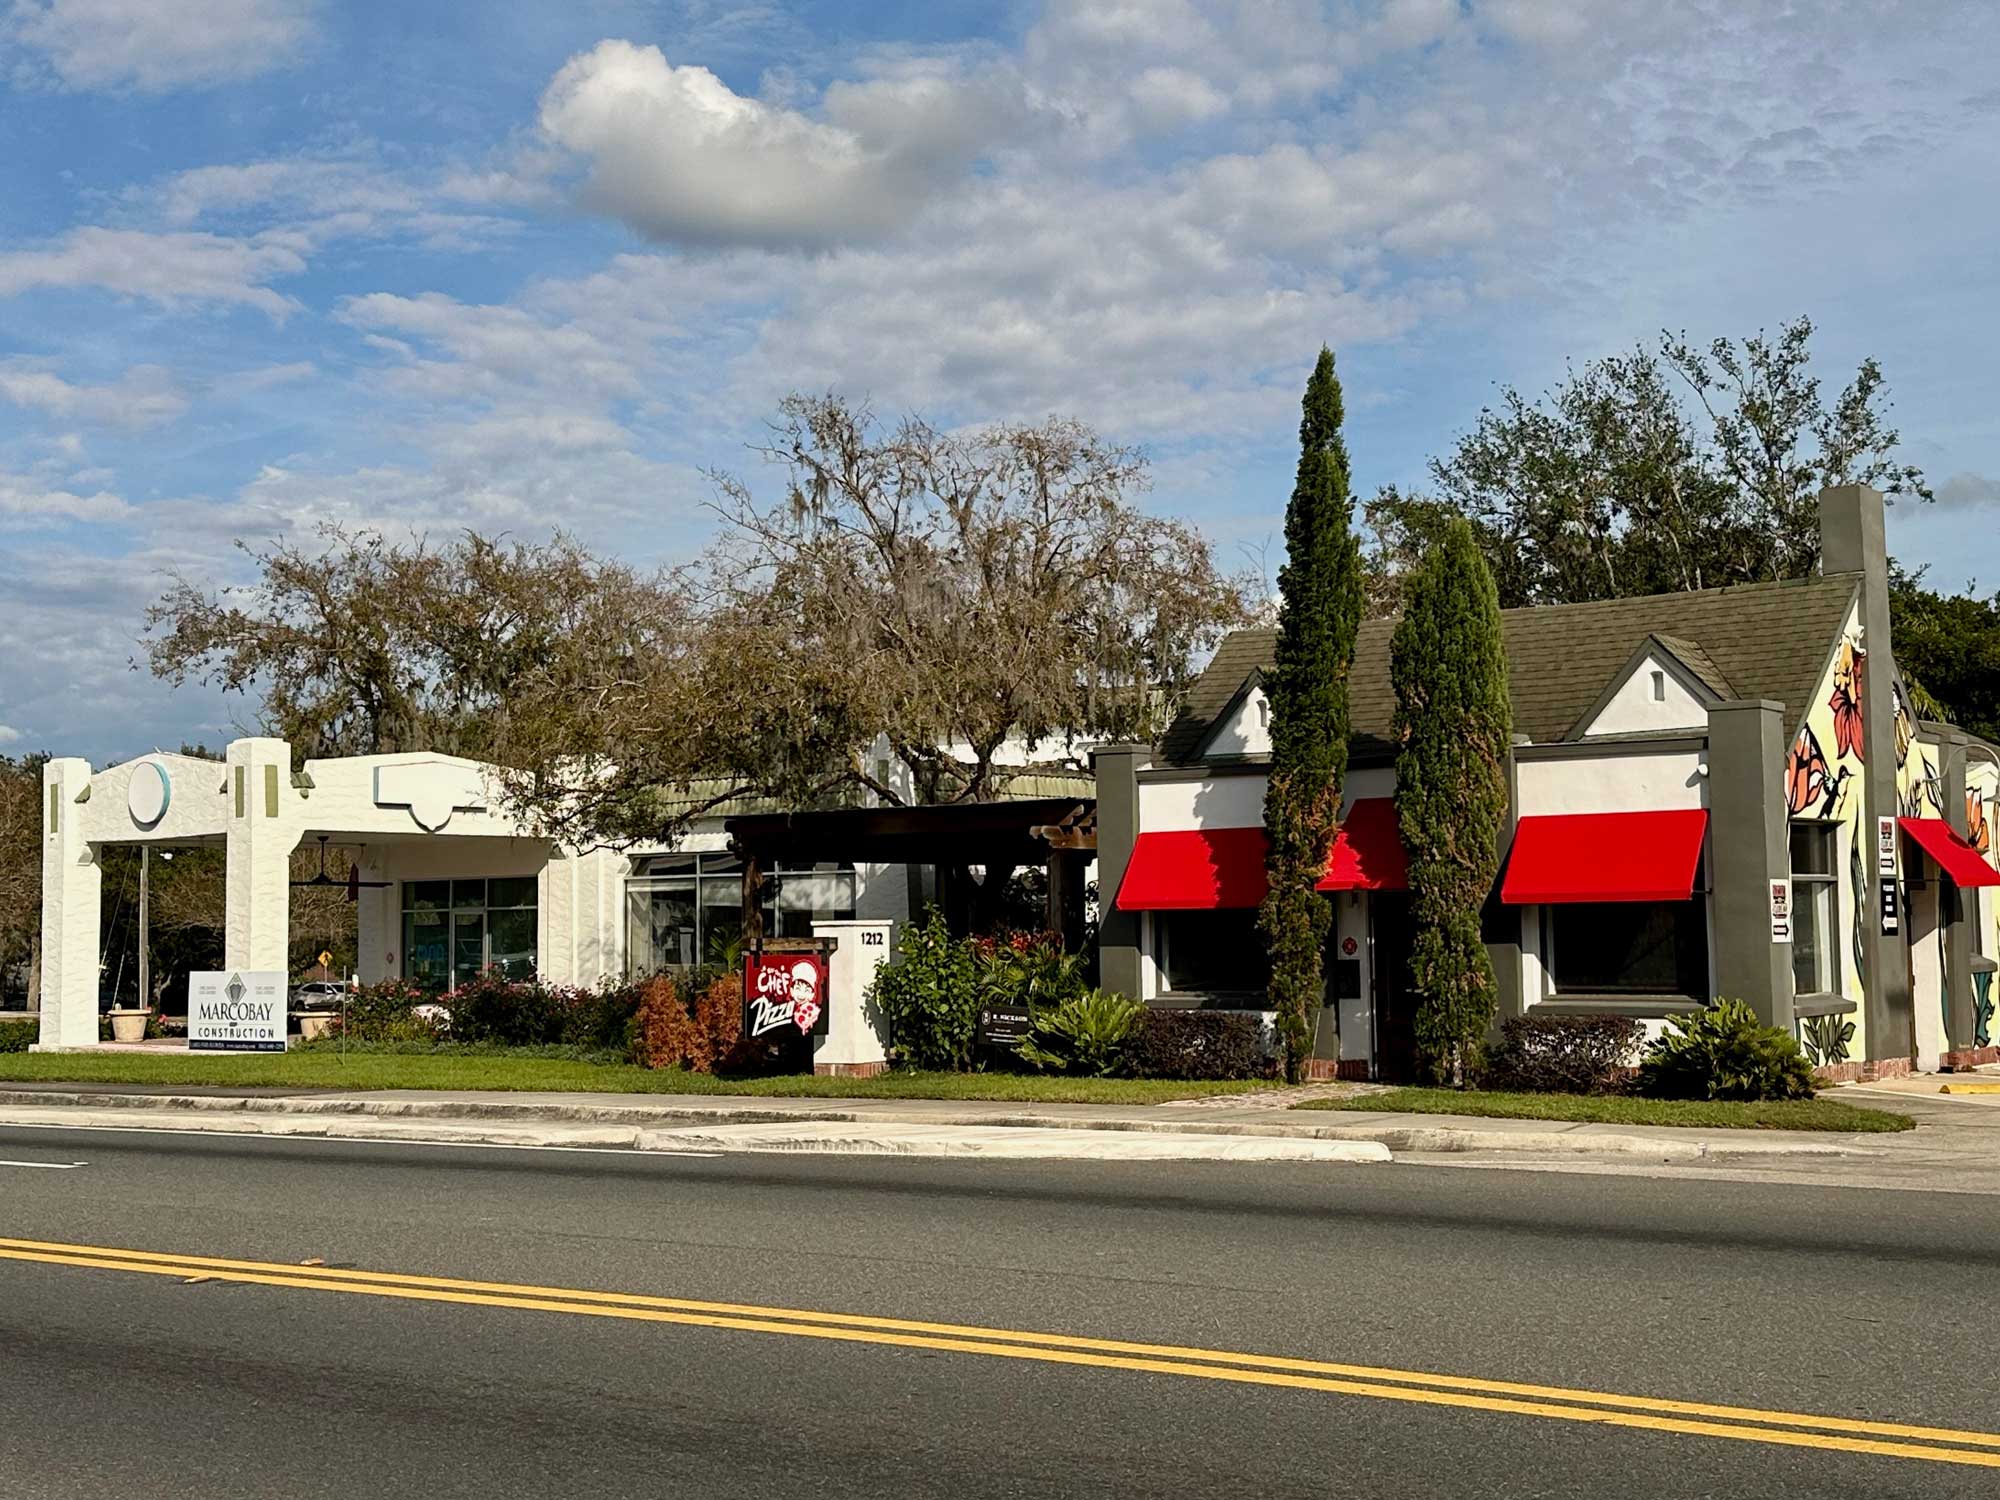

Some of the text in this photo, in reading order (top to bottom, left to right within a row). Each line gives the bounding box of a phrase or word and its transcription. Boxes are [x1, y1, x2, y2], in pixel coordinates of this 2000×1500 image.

[861, 932, 883, 945] 1212
[757, 971, 790, 995] CHEF
[199, 1002, 274, 1021] MARCOBAY
[750, 995, 795, 1036] Pizza
[198, 1027, 274, 1038] CONSTRUCTION
